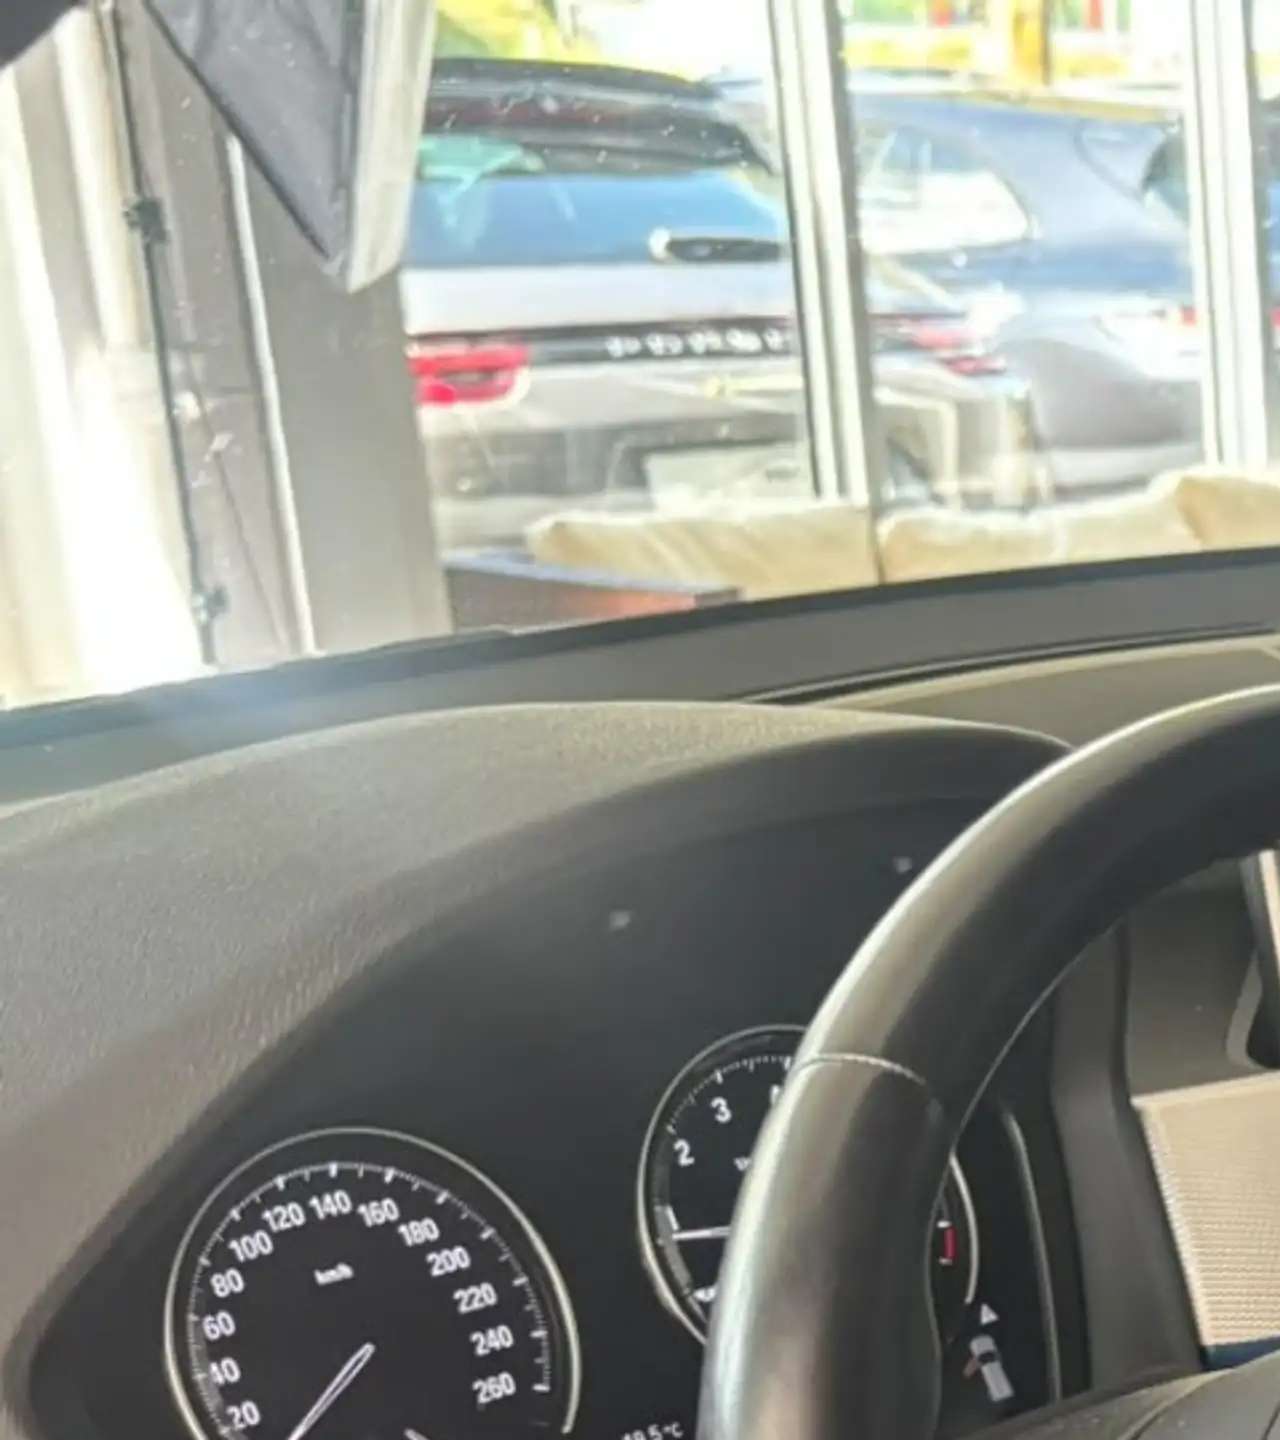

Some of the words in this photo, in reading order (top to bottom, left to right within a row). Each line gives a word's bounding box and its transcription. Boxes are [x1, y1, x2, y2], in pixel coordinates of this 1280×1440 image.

[711, 1097, 732, 1122] 3
[674, 1138, 695, 1167] 2
[262, 1202, 306, 1233] 120
[309, 1190, 353, 1220] 140
[357, 1198, 400, 1227] 160
[228, 1229, 274, 1263] 100
[398, 1217, 440, 1247] 180
[426, 1245, 471, 1277] 200
[210, 1268, 245, 1298] 80
[453, 1282, 498, 1314] 220
[202, 1310, 237, 1341] 60
[470, 1325, 514, 1356] 240
[210, 1357, 241, 1385] 40
[472, 1371, 516, 1404] 260
[227, 1401, 261, 1430] 20
